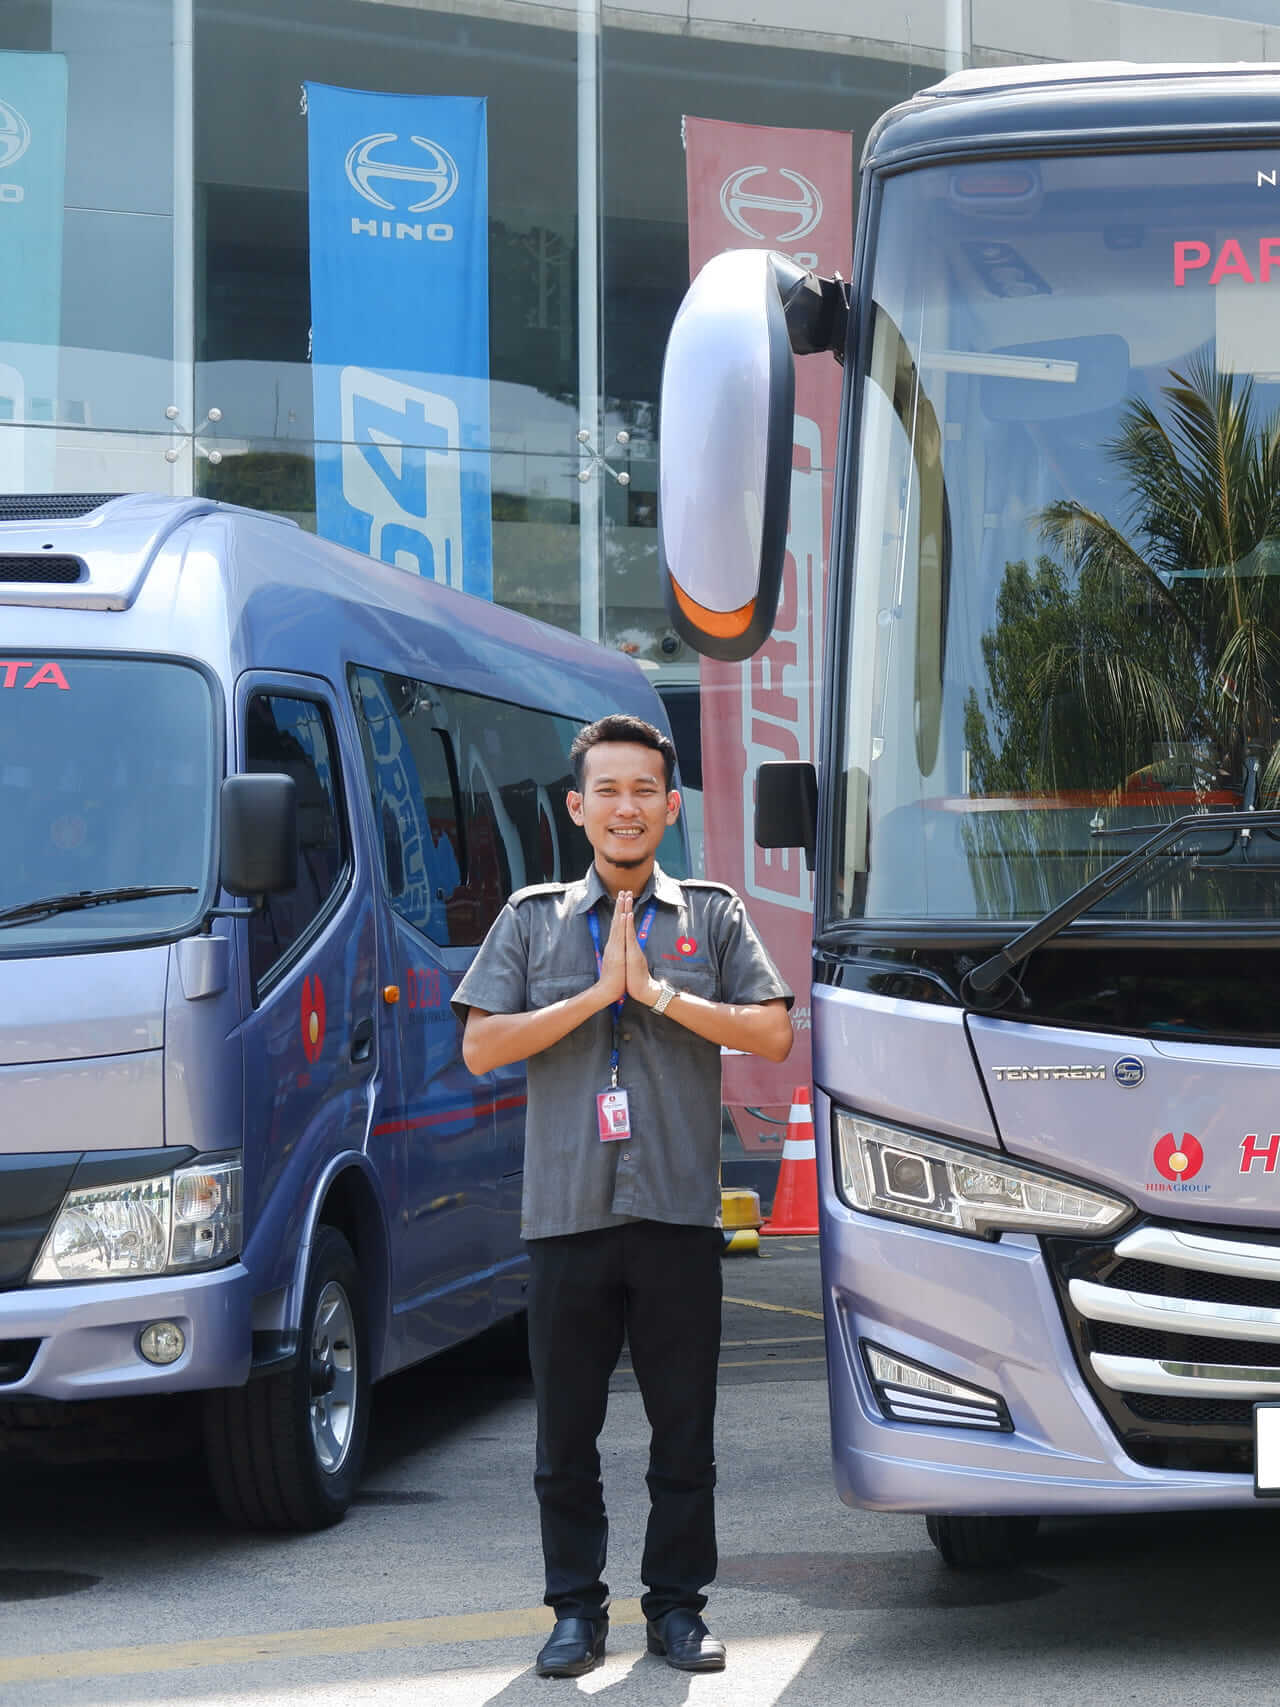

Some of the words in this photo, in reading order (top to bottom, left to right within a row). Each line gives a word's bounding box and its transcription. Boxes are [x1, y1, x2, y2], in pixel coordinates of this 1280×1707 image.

[351, 217, 454, 242] HINO
[0, 661, 72, 691] TA
[991, 1064, 1107, 1081] TENTREM
